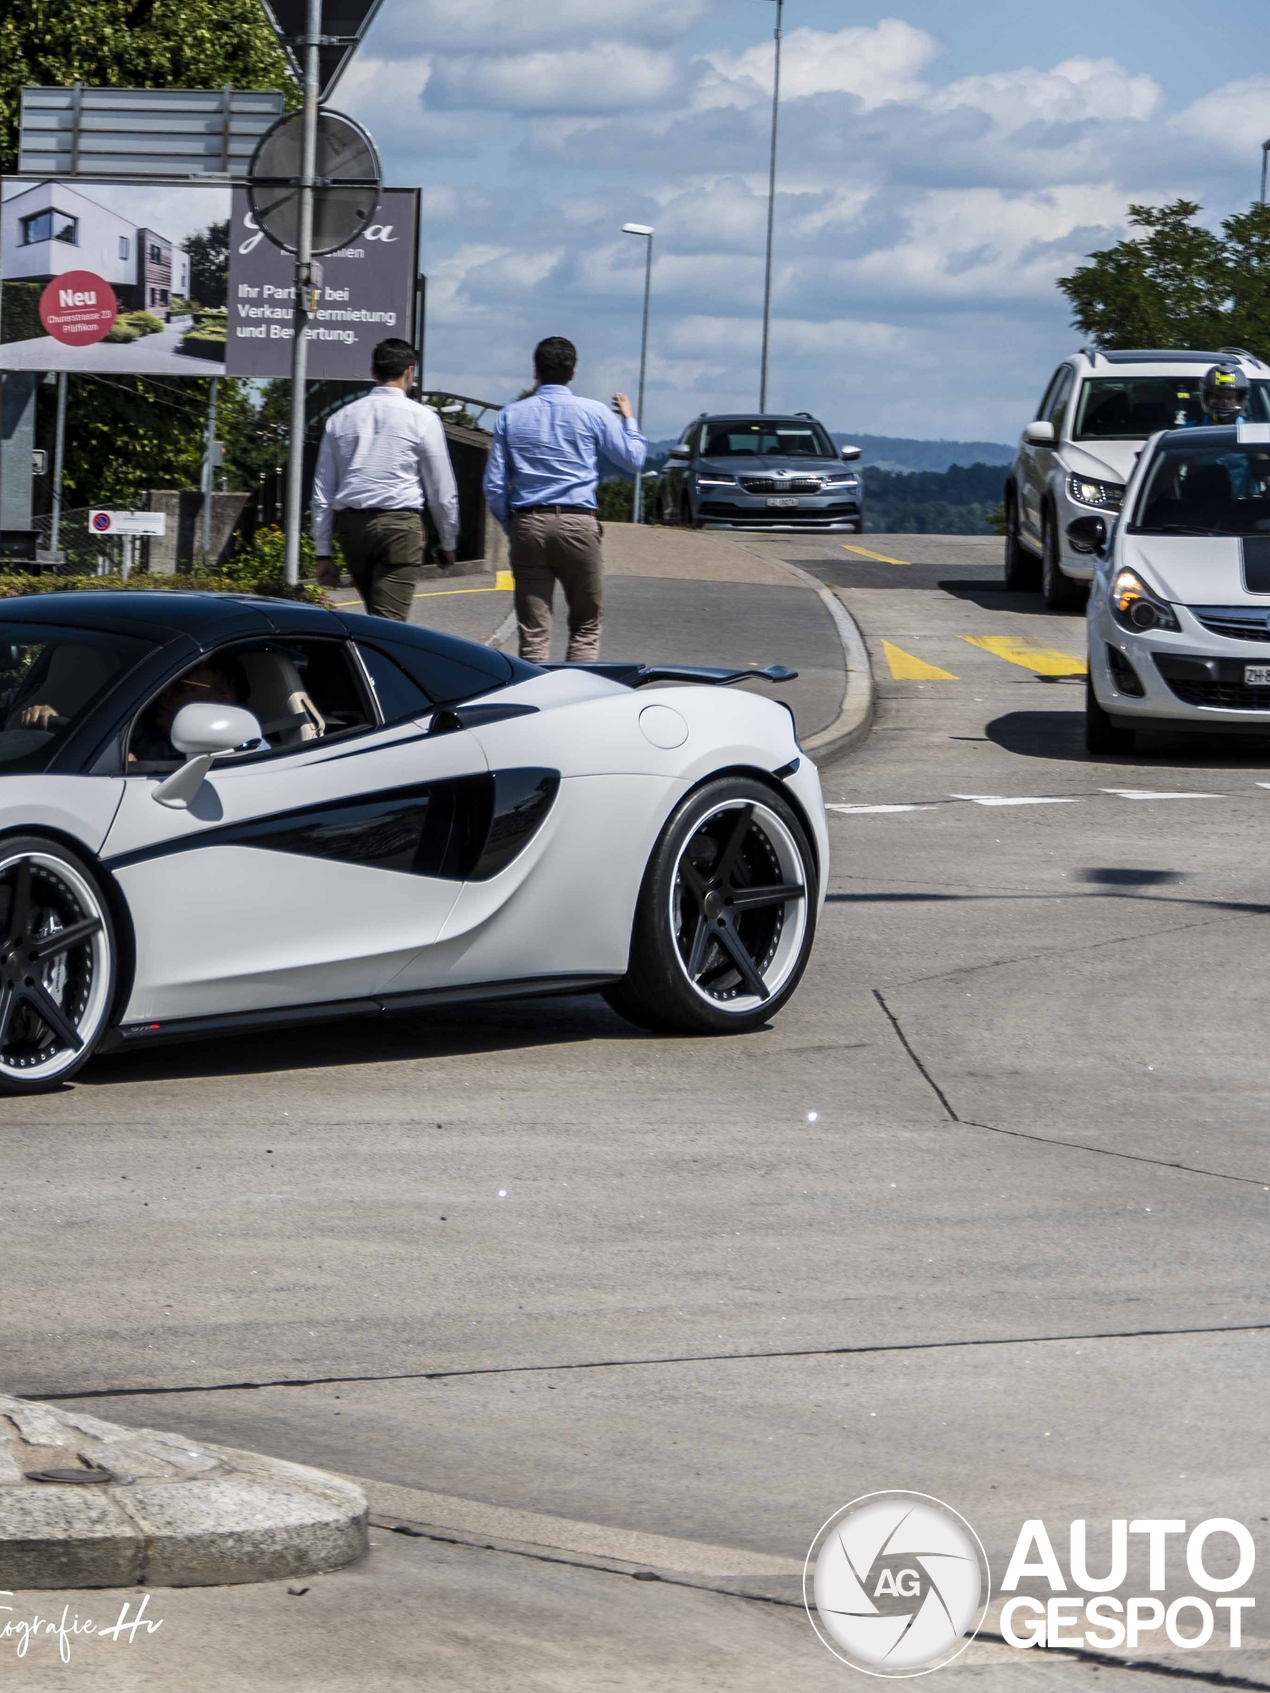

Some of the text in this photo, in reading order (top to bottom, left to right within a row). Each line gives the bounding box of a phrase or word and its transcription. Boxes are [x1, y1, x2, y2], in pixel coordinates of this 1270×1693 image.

[58, 288, 97, 308] Neu
[238, 283, 350, 301] Ihr Partr bei
[236, 324, 267, 339] und
